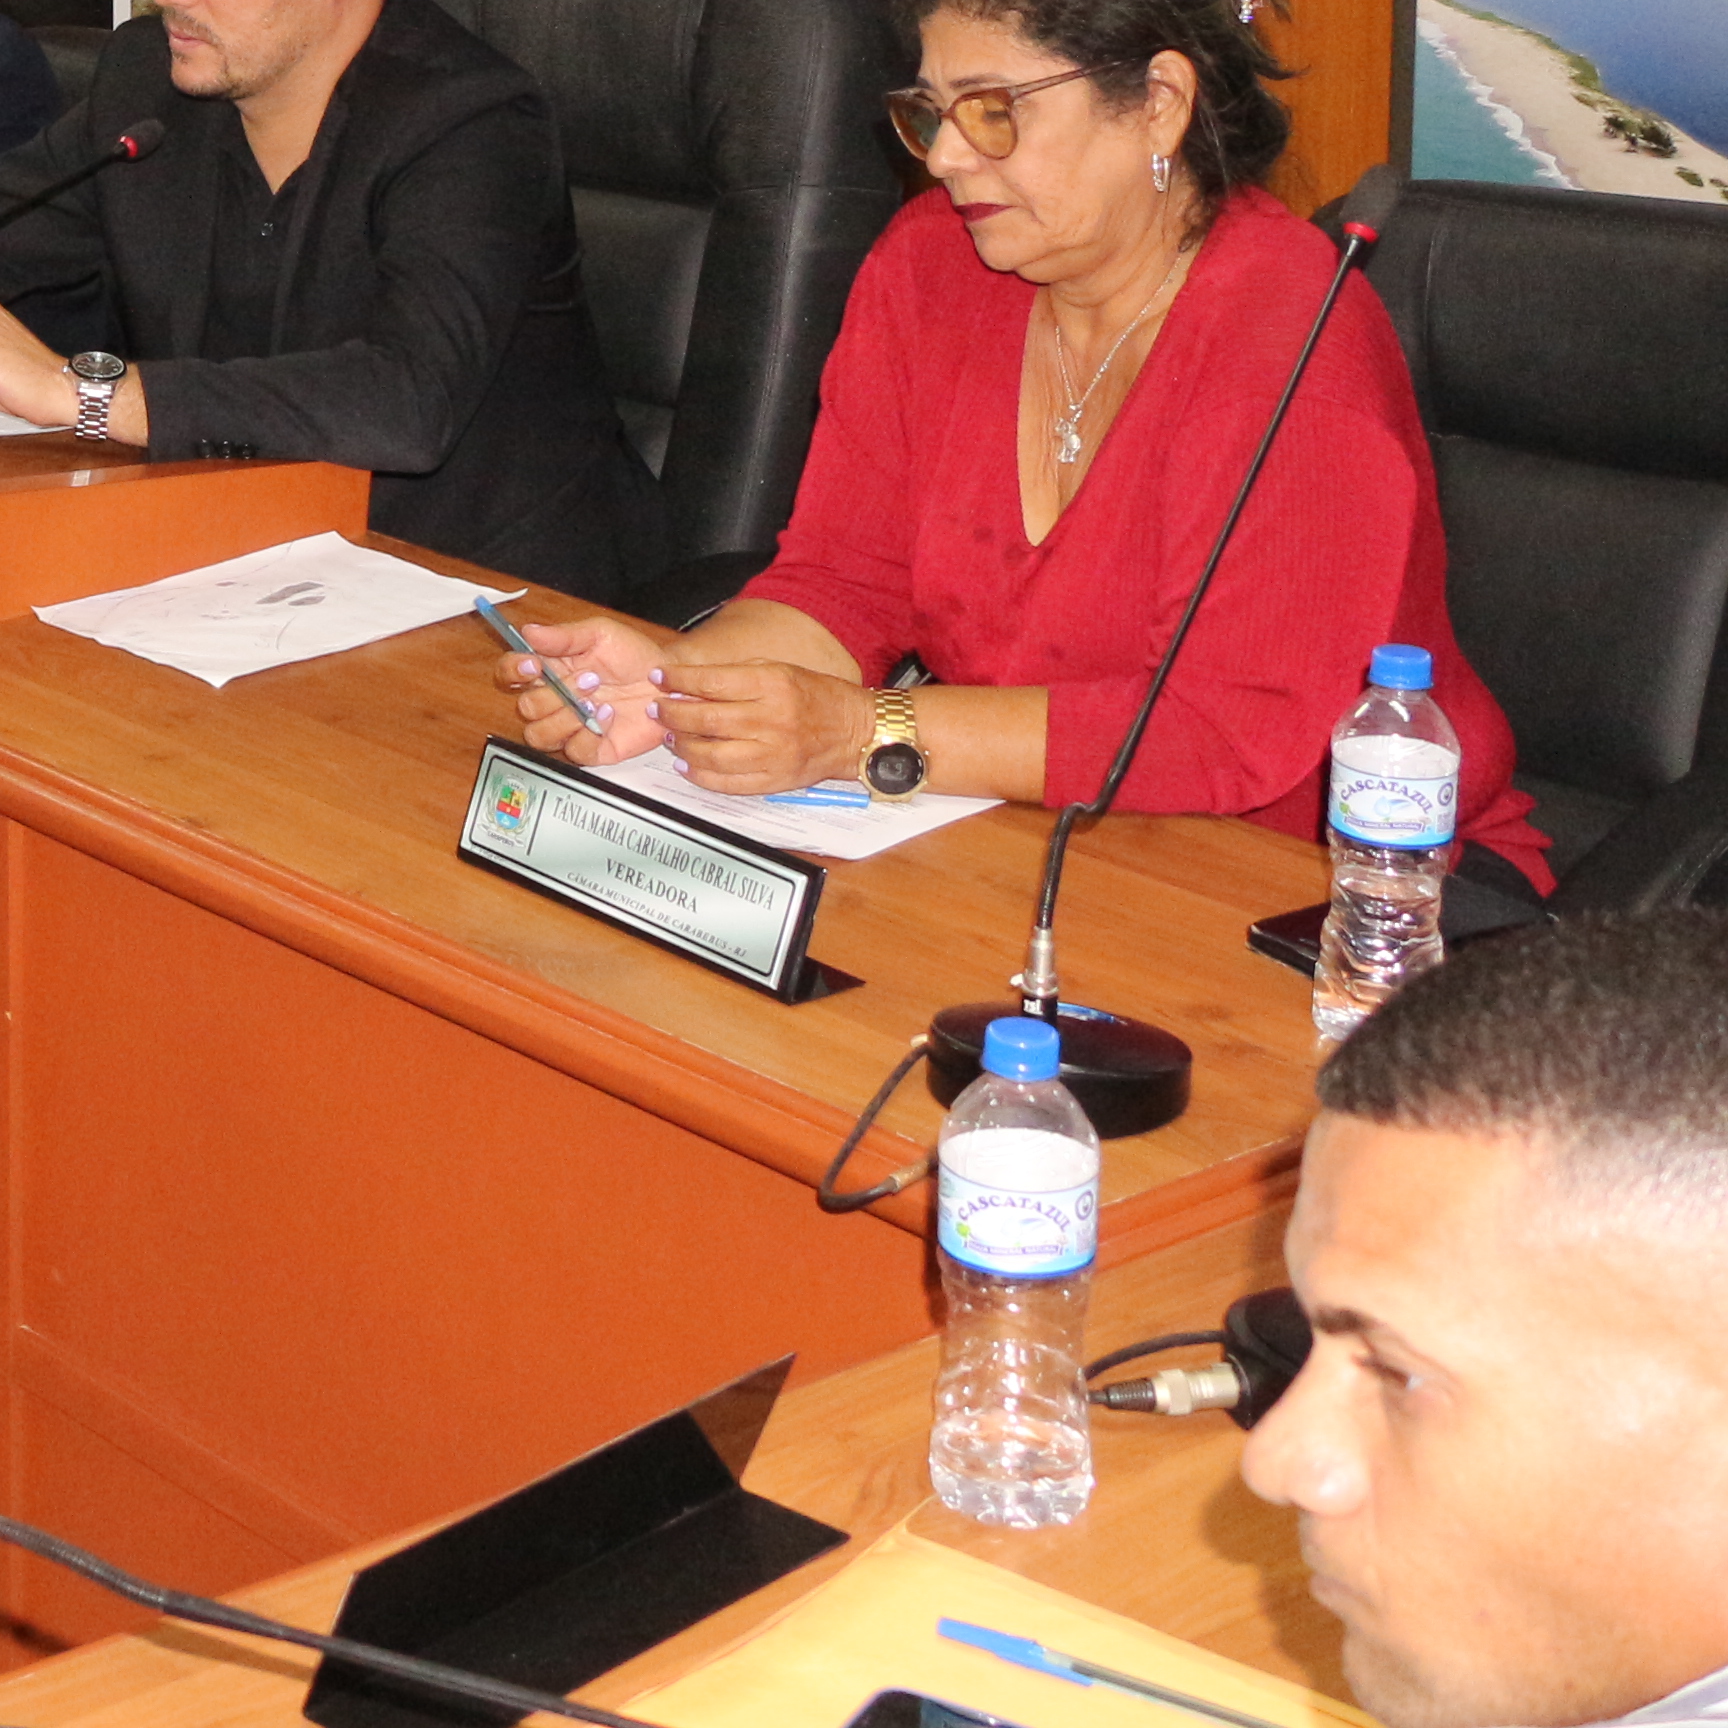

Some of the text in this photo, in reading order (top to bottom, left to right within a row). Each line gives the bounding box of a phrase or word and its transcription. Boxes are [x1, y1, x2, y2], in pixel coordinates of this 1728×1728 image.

[552, 794, 776, 911] TÂNIA MARIA CARVALHO CABRAL SILVA
[606, 857, 698, 913] VEREADORA
[566, 871, 606, 897] CÂMARA
[605, 888, 656, 918] MUNICIPAL
[656, 911, 670, 924] DE
[733, 945, 748, 958] RJ
[957, 1195, 1071, 1233] CASCATAZUL
